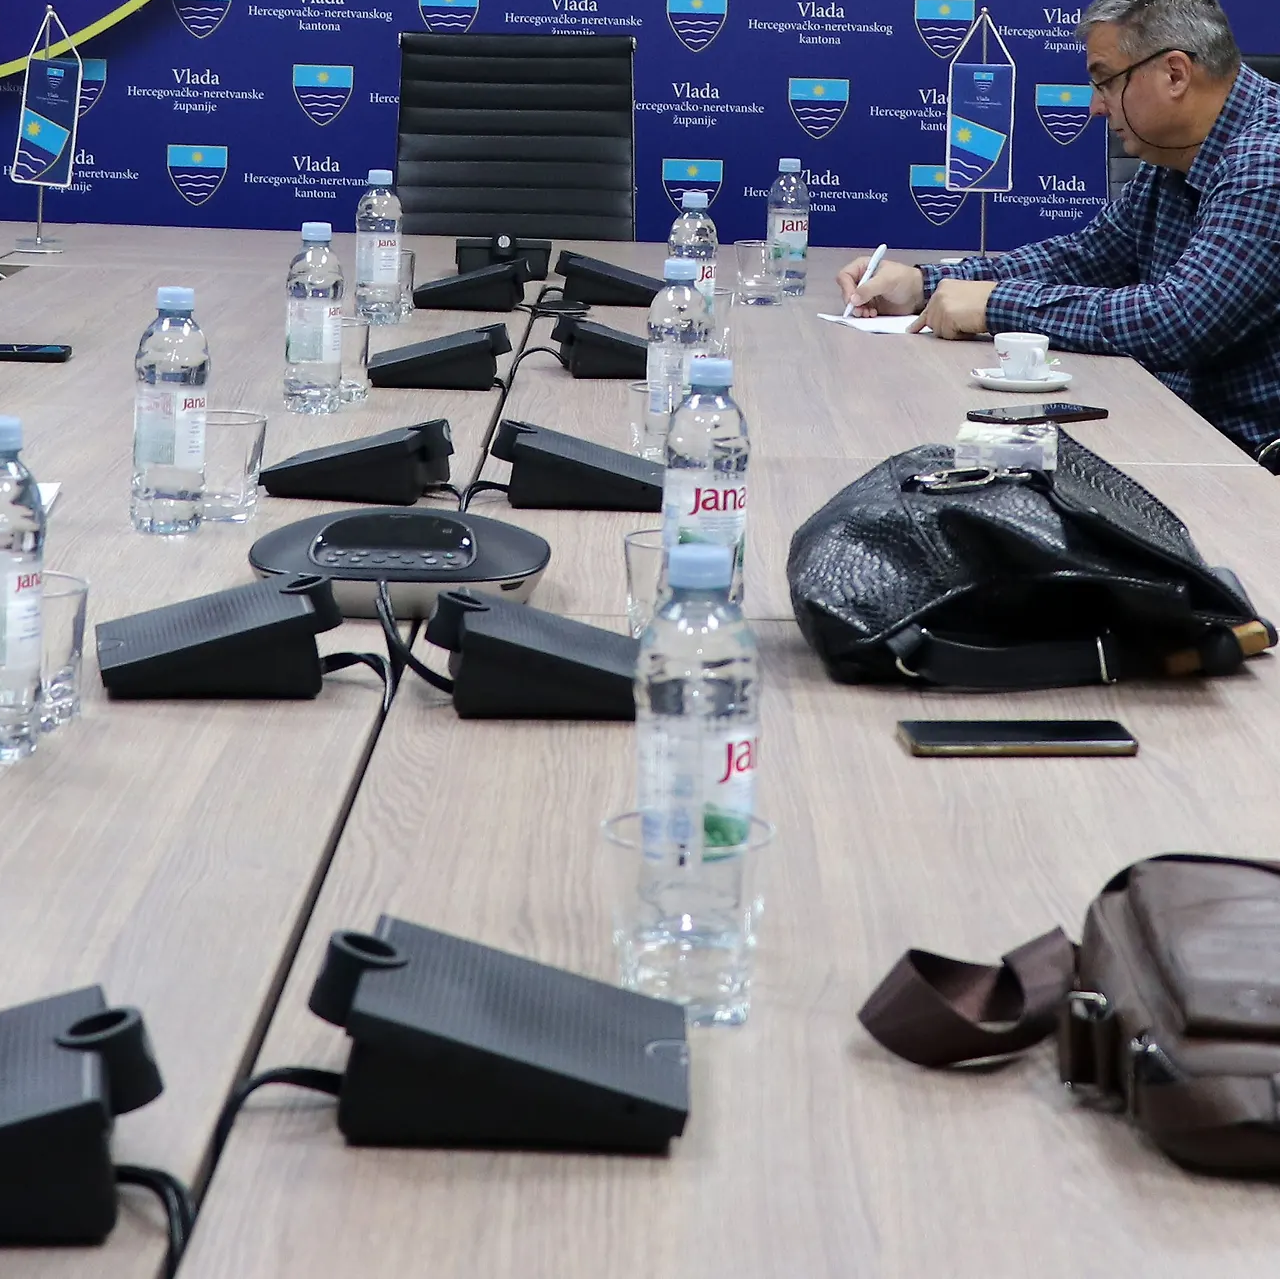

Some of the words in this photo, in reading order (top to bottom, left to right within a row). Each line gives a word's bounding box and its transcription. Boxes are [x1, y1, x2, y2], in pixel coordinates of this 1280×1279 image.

[248, 4, 393, 23] Hercegovačko-neretvanskog
[796, 1, 845, 19] Vlada
[1042, 7, 1081, 25] Vlad
[298, 19, 341, 32] kantona
[504, 12, 643, 27] Hercegovačko-neretvanske
[748, 18, 894, 36] Hercegovačko-neretvanskog
[798, 32, 841, 45] kantona
[998, 24, 1075, 40] Hercegovačko-
[171, 68, 220, 86] Vlada
[127, 85, 265, 100] Hercegovačko-neretvanske
[671, 81, 721, 100] Vlada
[918, 87, 948, 105] Vla
[172, 100, 218, 115] županije
[869, 106, 947, 120] Hercegovačko-
[672, 114, 718, 129] županije
[920, 120, 948, 132] kanto
[292, 155, 341, 173] Vlada
[243, 172, 369, 187] Hercegovačko-neretvans
[1037, 174, 1087, 192] Vlada
[294, 186, 337, 199] kantona
[743, 186, 889, 203] Herco-neretvanskog
[992, 192, 1108, 206] Hercegovačko-neretva
[809, 202, 837, 213] ntona
[1039, 206, 1084, 221] županije
